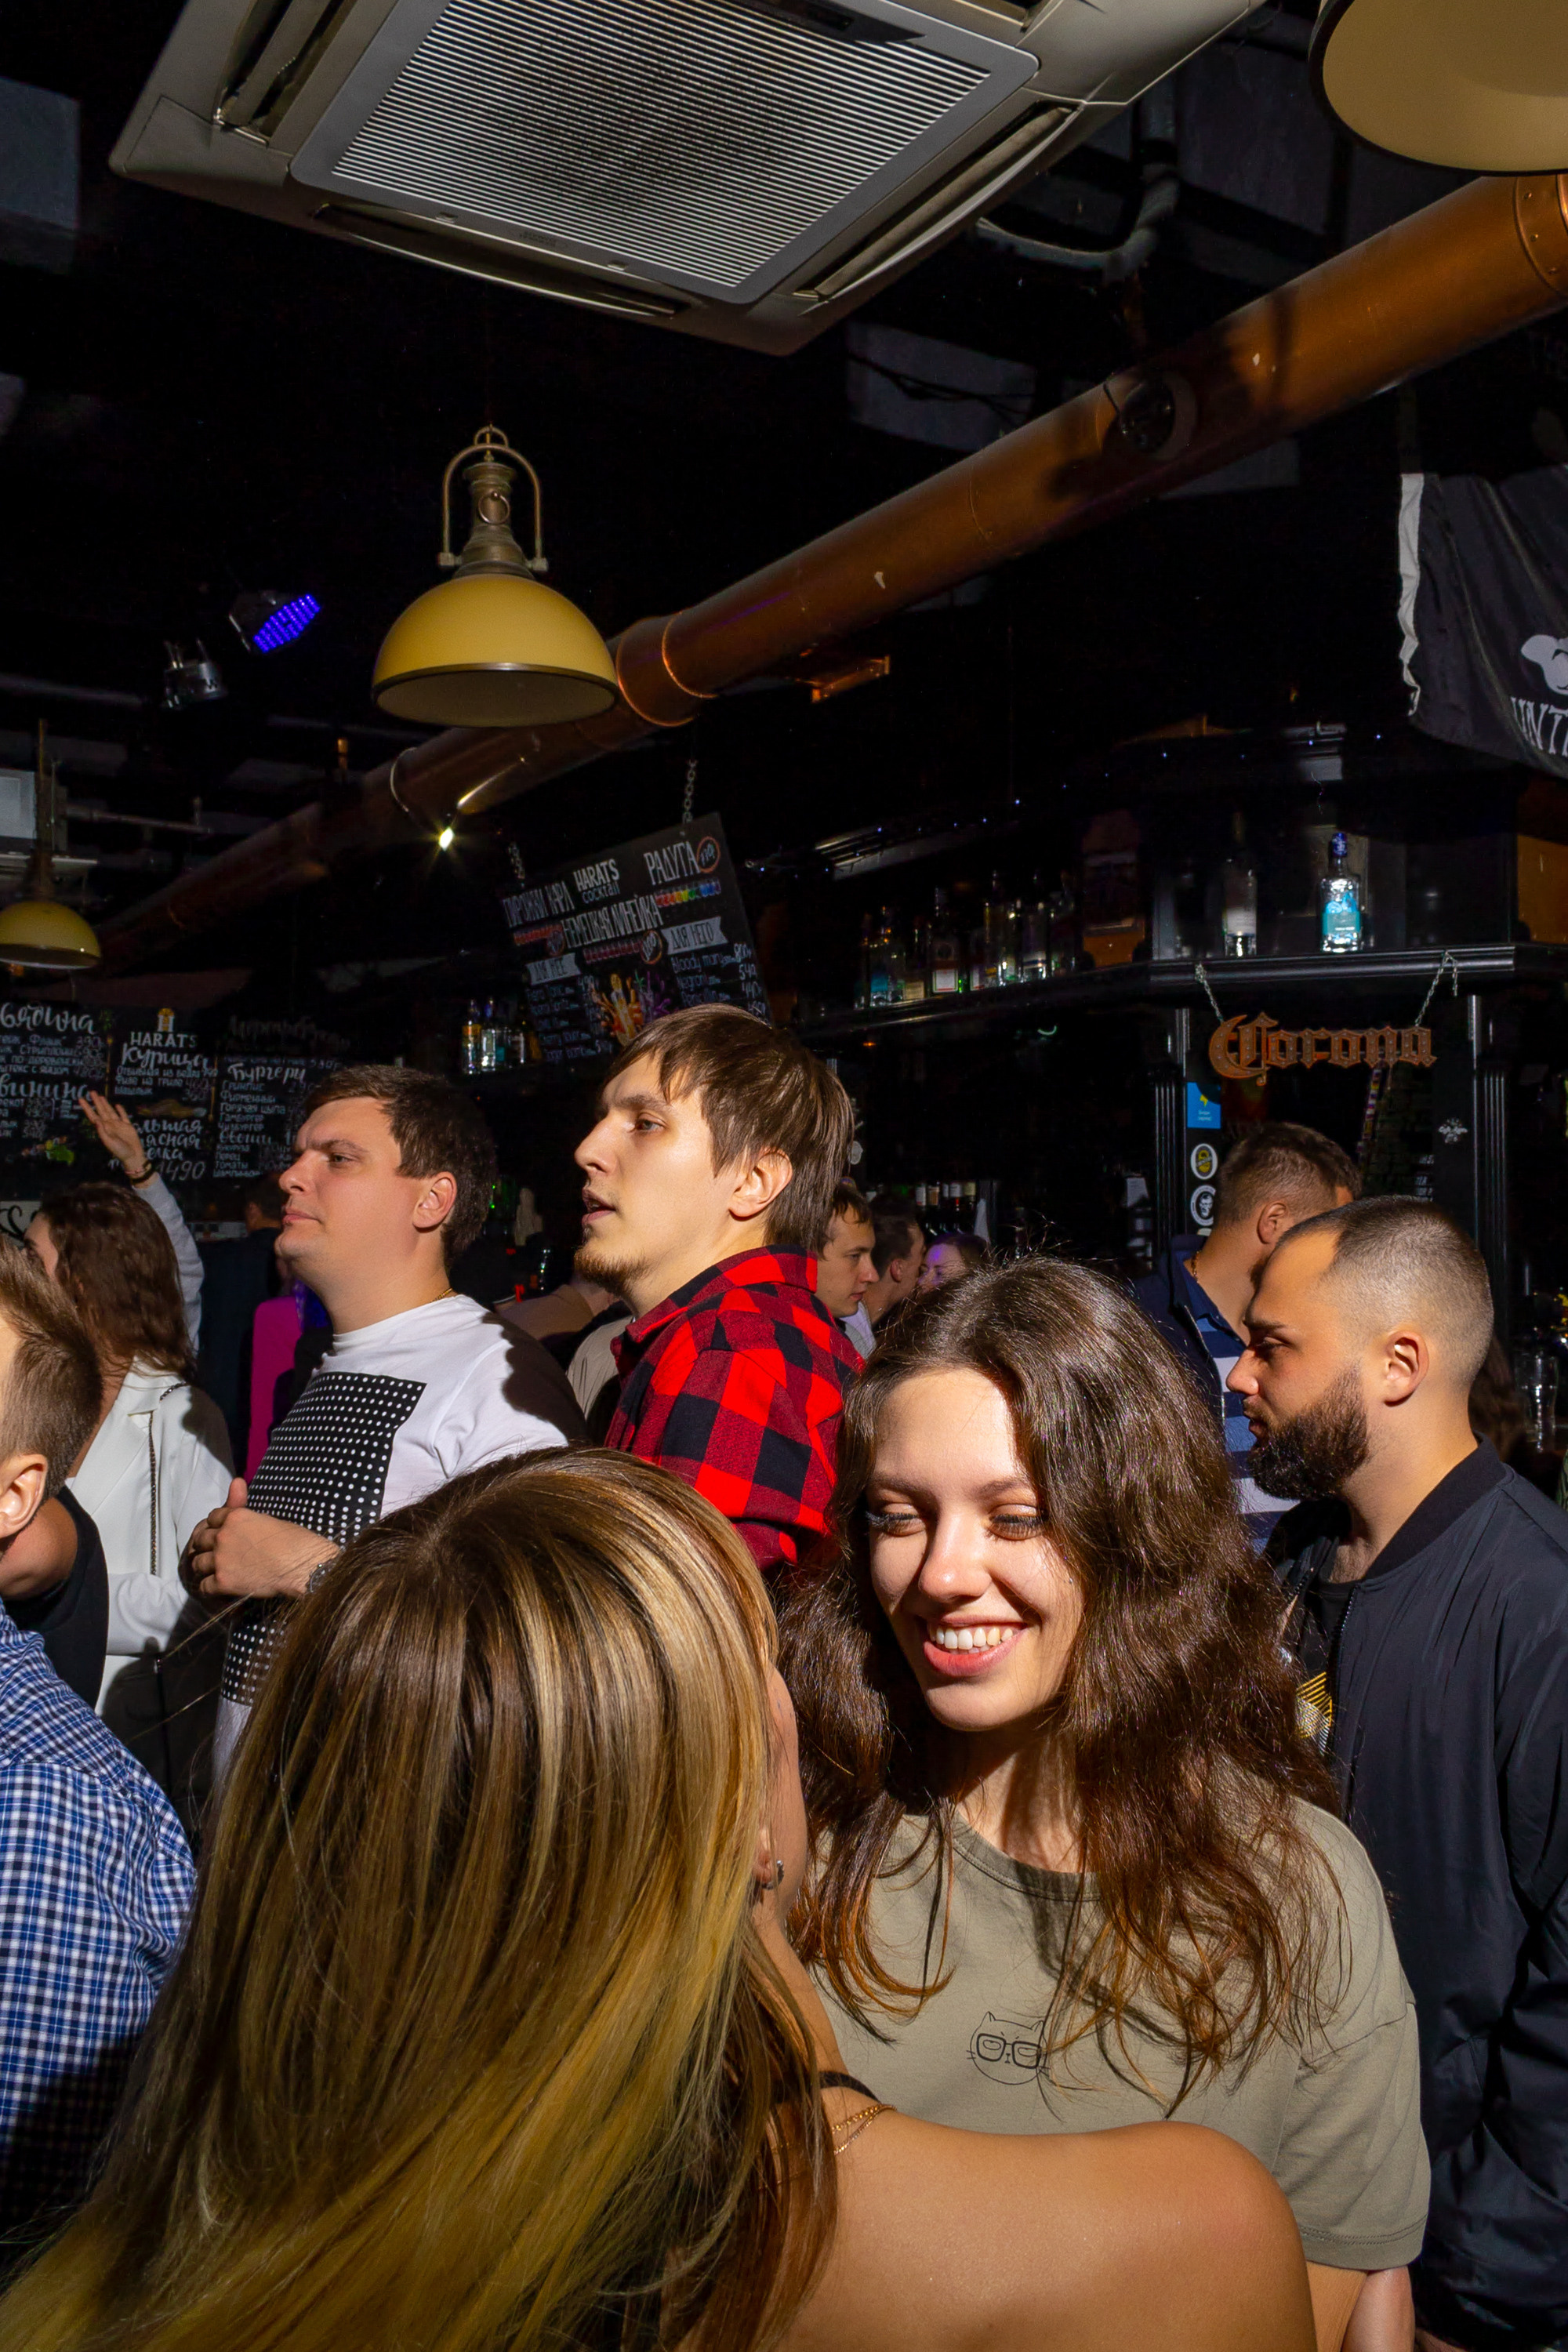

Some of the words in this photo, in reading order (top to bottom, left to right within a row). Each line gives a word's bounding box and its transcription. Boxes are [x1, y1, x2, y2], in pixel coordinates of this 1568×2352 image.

[572, 858, 619, 892] HARATS
[643, 841, 701, 885] РАДУГА
[130, 1031, 198, 1048] HARATS
[1208, 1011, 1437, 1086] Corona
[122, 1043, 210, 1076] Курица
[227, 1062, 307, 1085] Бургеры
[140, 1133, 201, 1151] ясная
[156, 1160, 206, 1181] 1490
